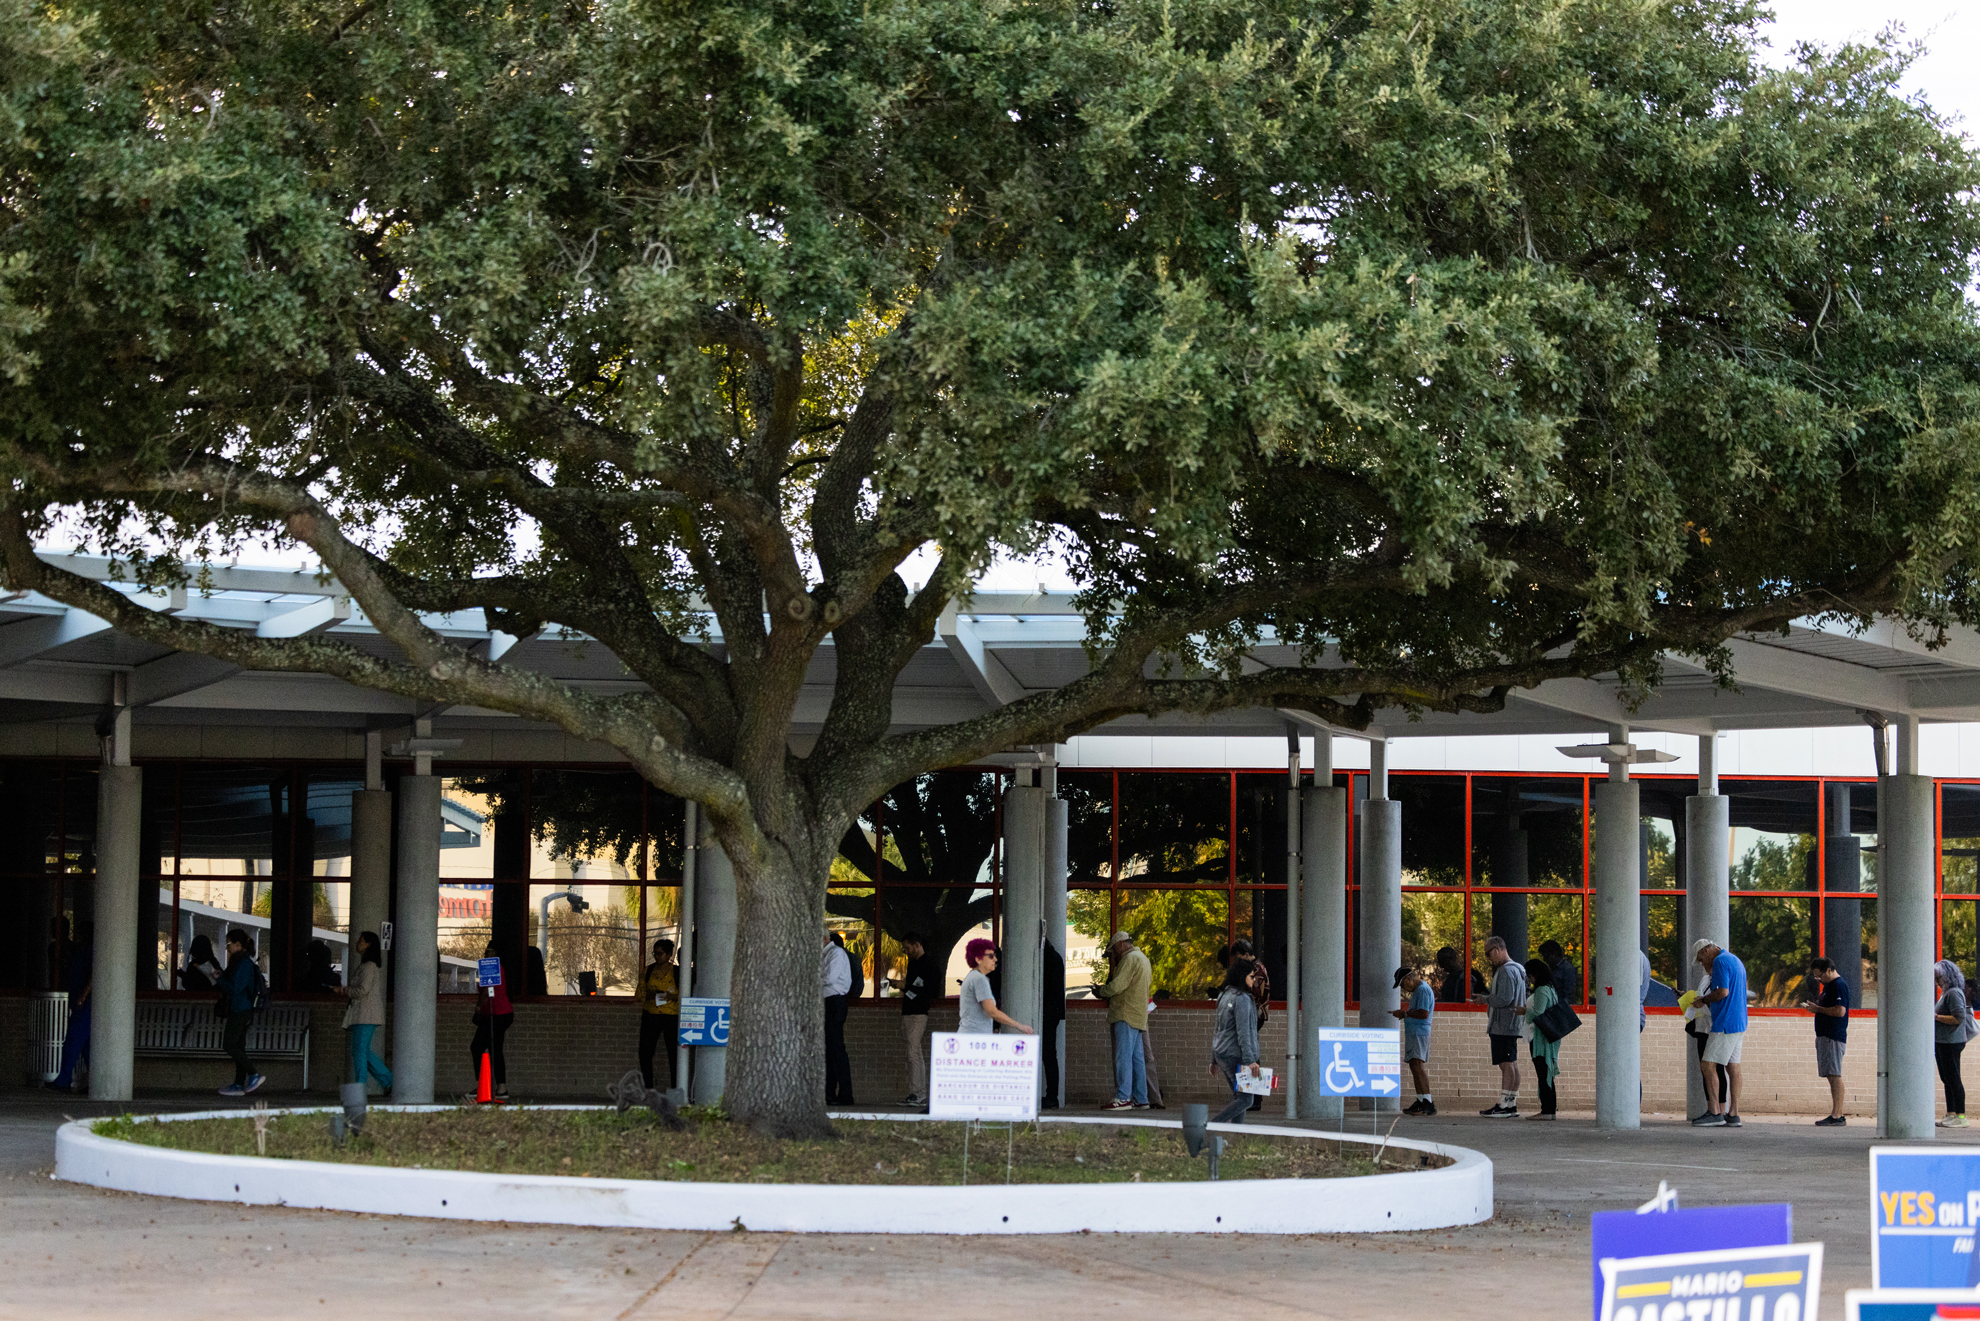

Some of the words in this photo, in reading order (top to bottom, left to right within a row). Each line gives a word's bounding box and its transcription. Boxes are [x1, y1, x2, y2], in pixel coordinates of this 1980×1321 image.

[969, 1042, 987, 1050] 100
[935, 1058, 987, 1067] DISTANCE
[991, 1060, 1033, 1068] MARKER
[1880, 1191, 1936, 1226] YES
[1938, 1201, 1964, 1226] ON
[1671, 1270, 1743, 1298] MARIO
